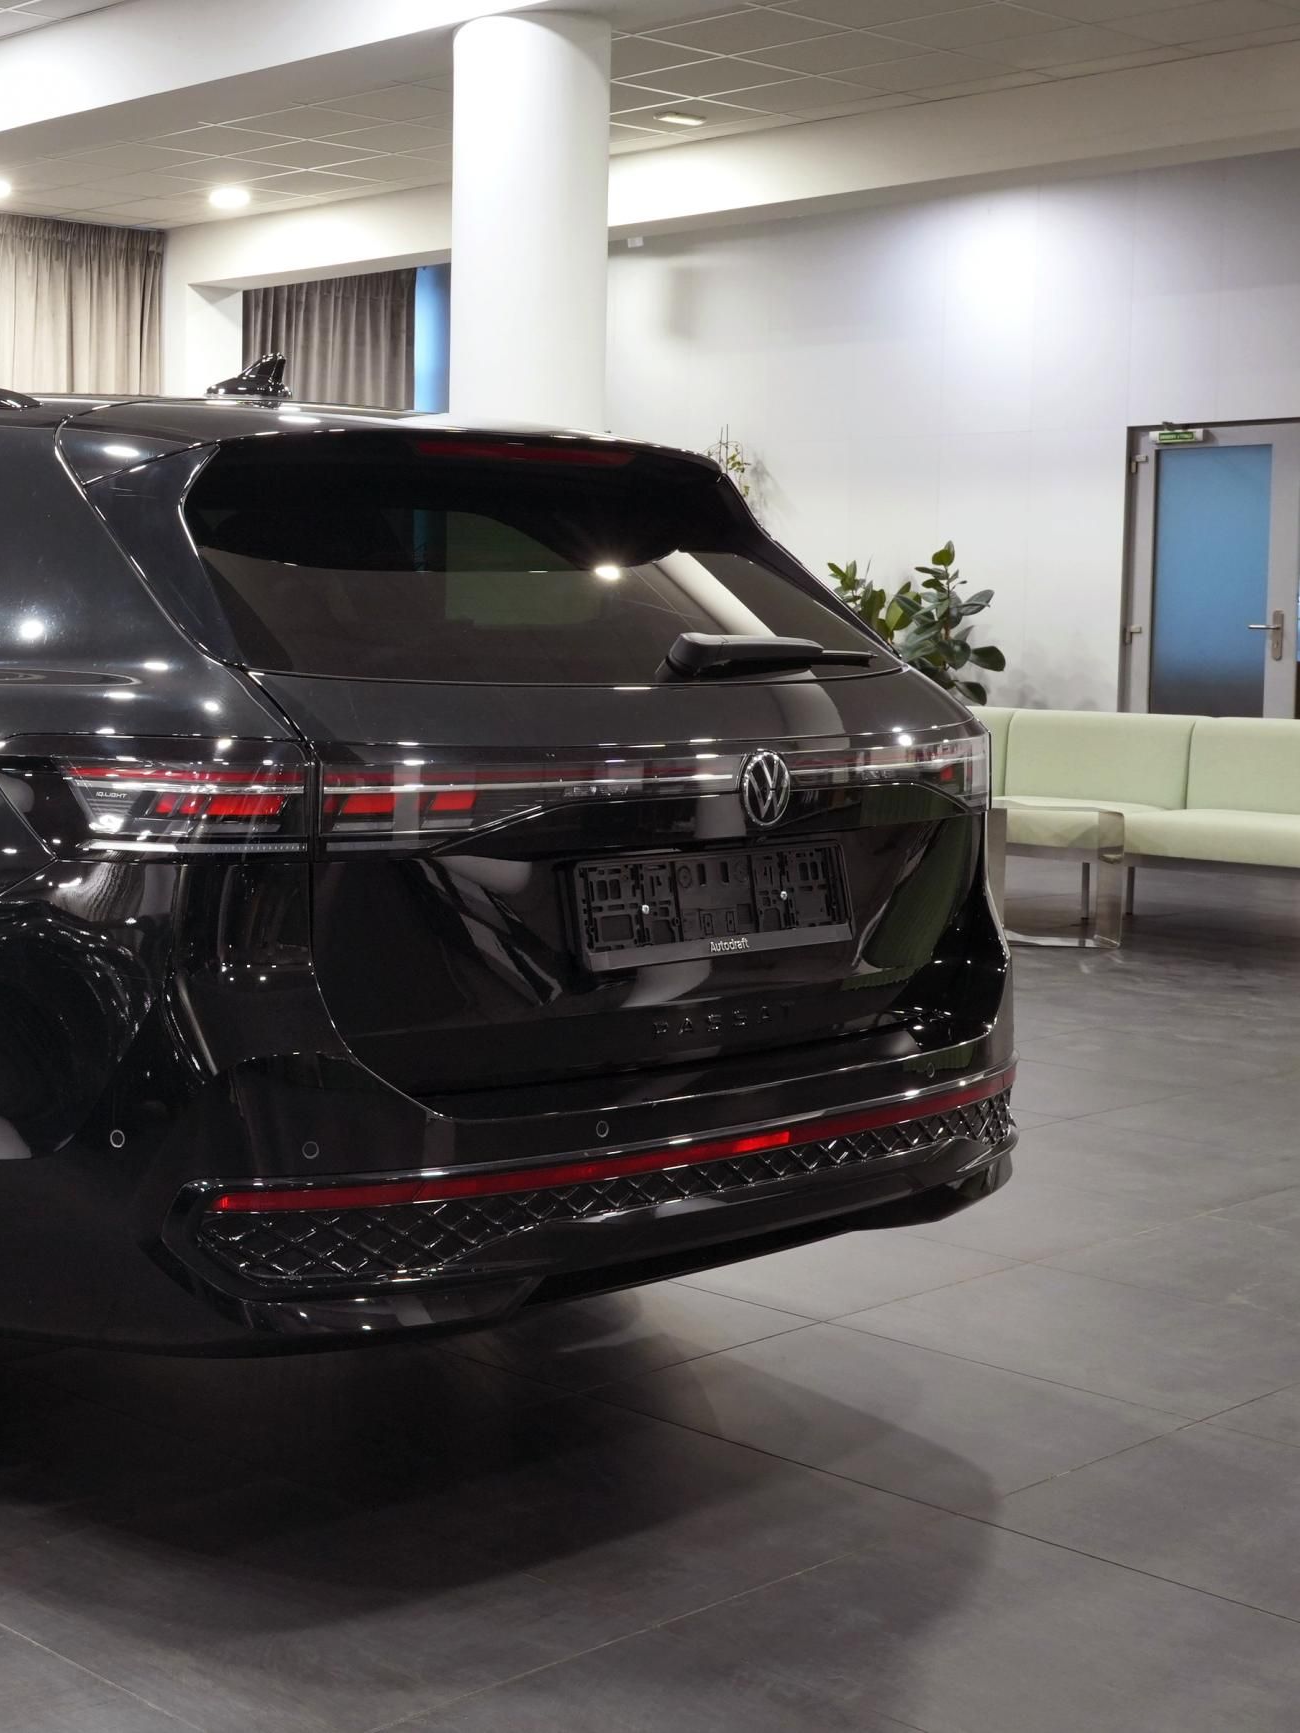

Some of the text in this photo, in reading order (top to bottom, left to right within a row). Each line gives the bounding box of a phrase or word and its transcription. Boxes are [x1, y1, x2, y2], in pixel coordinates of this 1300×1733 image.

[95, 791, 128, 799] IQ.LIGHT
[743, 749, 791, 826] VW
[710, 937, 750, 953] Autodraft
[652, 1000, 795, 1040] PASSAT
